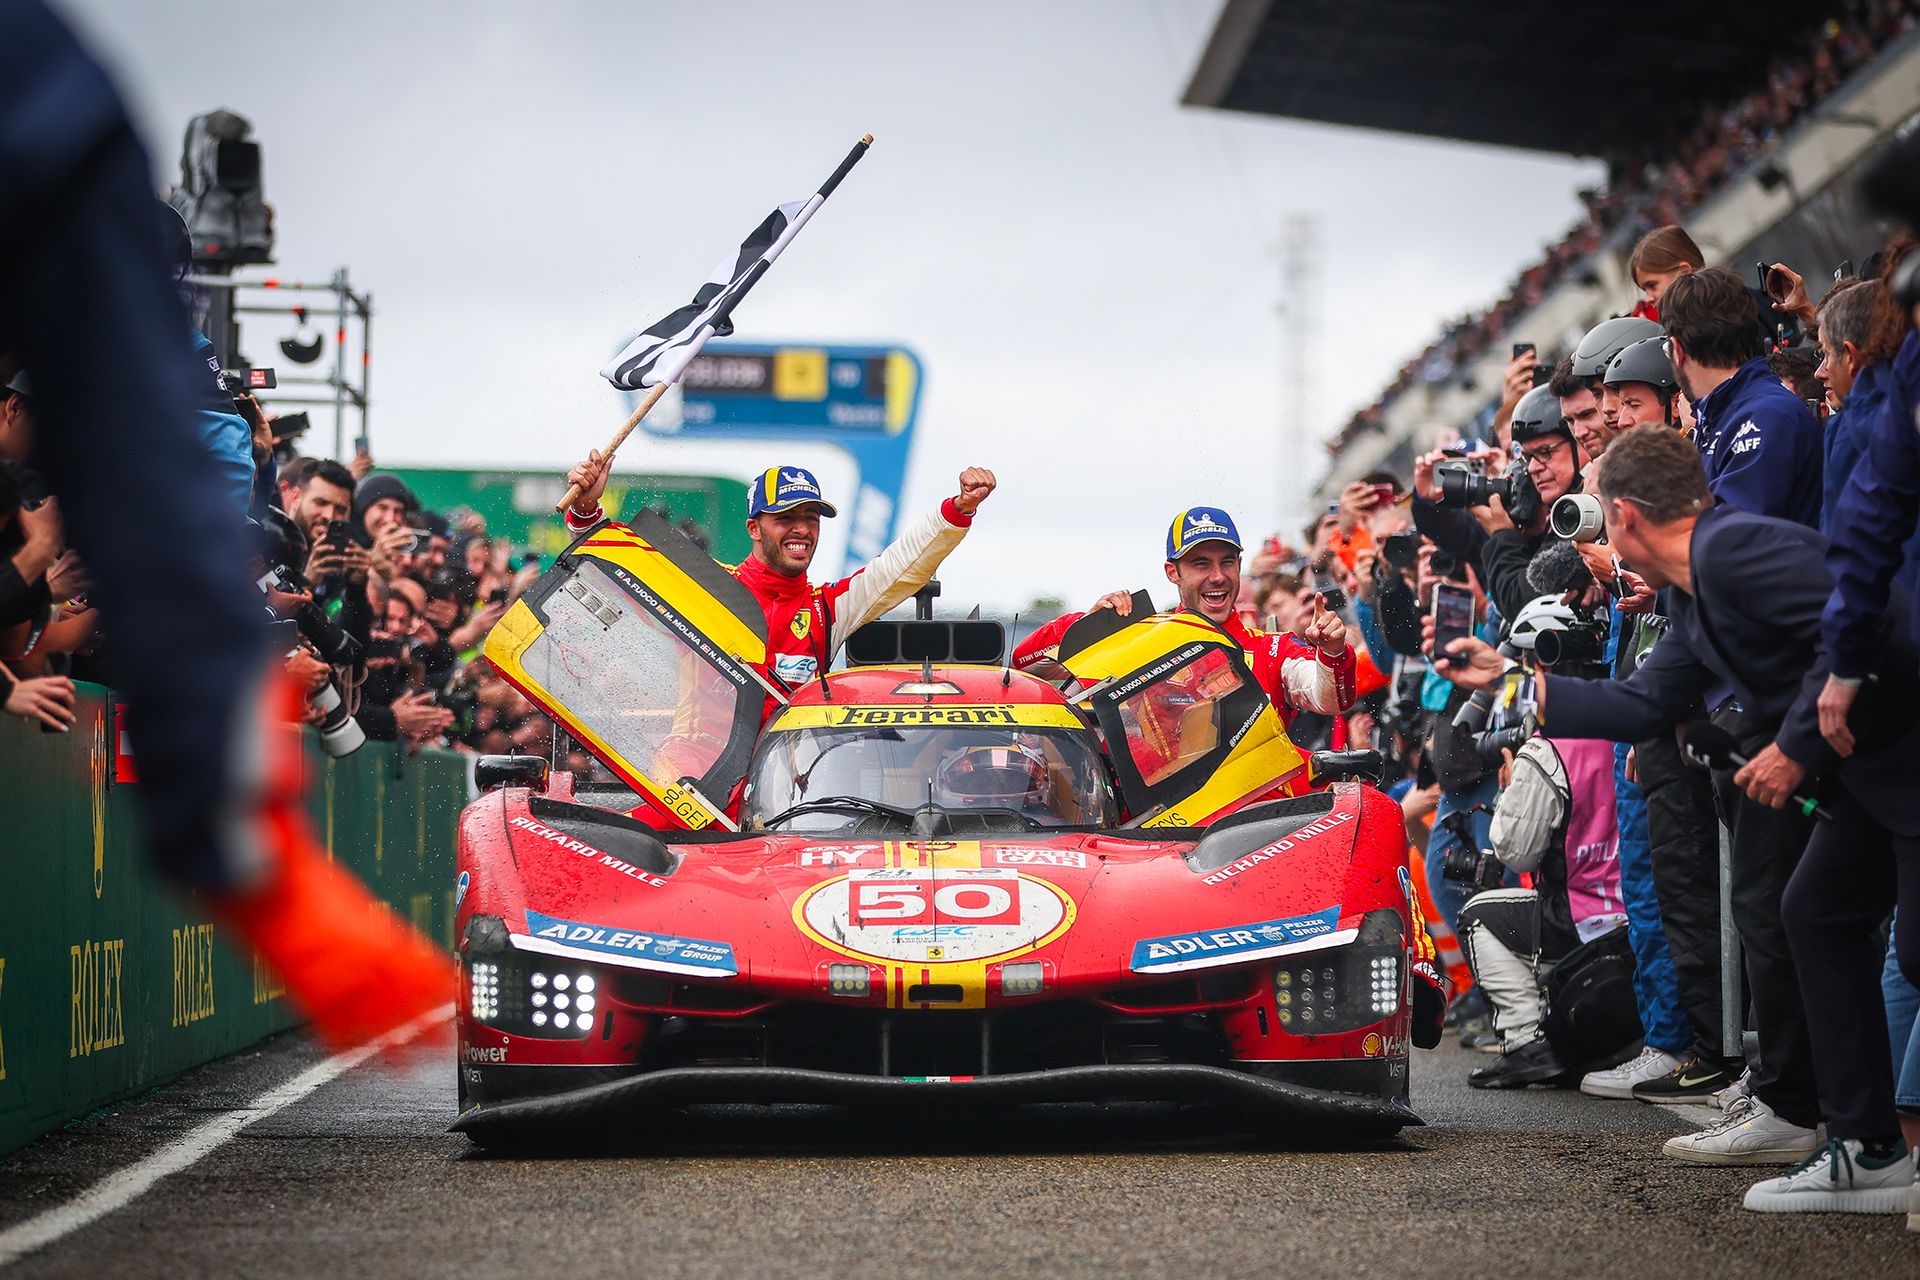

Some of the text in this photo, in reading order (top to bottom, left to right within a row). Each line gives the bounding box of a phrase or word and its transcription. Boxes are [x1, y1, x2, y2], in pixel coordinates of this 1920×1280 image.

[778, 485, 819, 496] MICHELIN
[1183, 527, 1229, 540] MICHELIN
[837, 706, 1018, 725] Ferrari
[509, 816, 668, 888] RICHARD MILLE
[1201, 811, 1355, 886] RICHARD MILLE
[801, 850, 869, 866] HY
[1001, 855, 1081, 867] CAR
[858, 883, 1012, 919] 50
[1283, 919, 1325, 930] PELZER
[1290, 925, 1332, 937] GROUP
[536, 923, 654, 951] ADLER
[1148, 929, 1260, 959] ADLER
[680, 950, 724, 962] GROUP
[686, 943, 730, 955] PELZER
[172, 923, 215, 1027] ROLEX
[71, 938, 124, 1058] ROLEX
